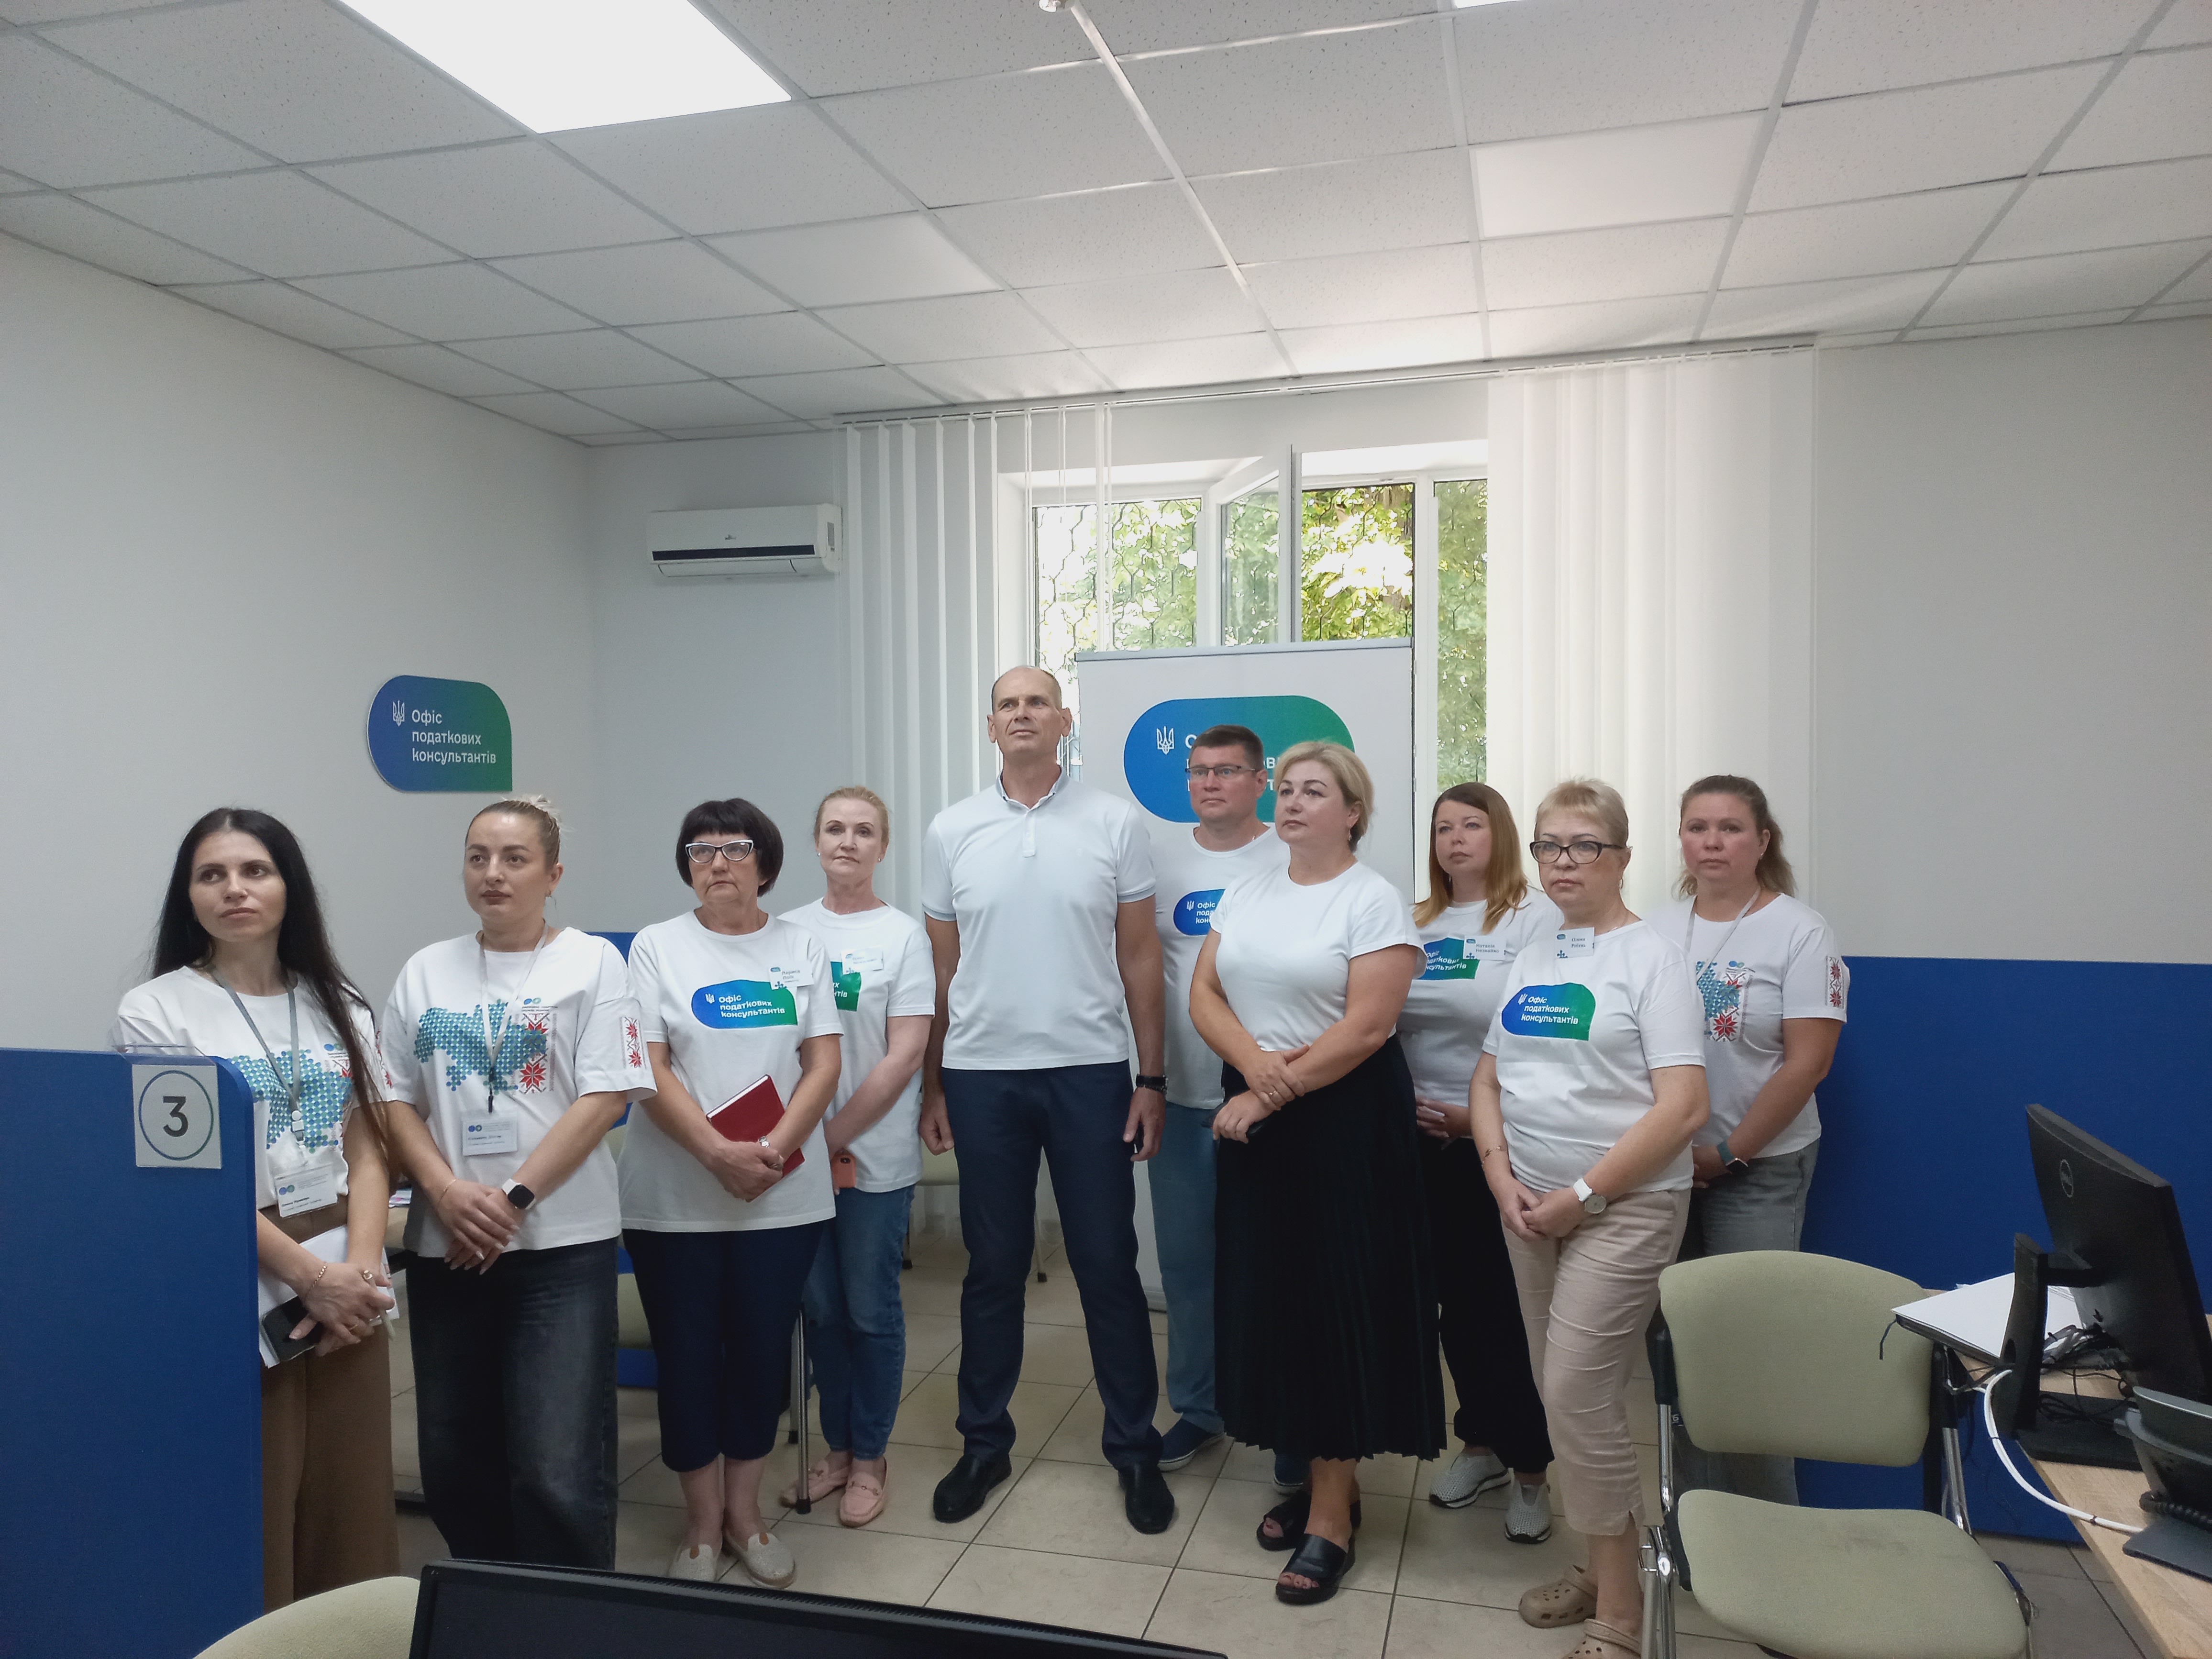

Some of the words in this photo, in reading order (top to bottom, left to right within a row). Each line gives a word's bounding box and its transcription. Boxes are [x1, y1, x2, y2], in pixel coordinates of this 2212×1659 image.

[411, 709, 442, 726] Офіс
[412, 730, 481, 745] податкових
[412, 748, 496, 765] консультантів
[1197, 901, 1216, 909] Офіс
[719, 995, 741, 1004] Офіс
[720, 1001, 772, 1011] податкових
[1524, 1005, 1570, 1013] податкових
[721, 1007, 785, 1018] консультантів
[1521, 1013, 1579, 1024] консультантів
[163, 1096, 188, 1137] 3
